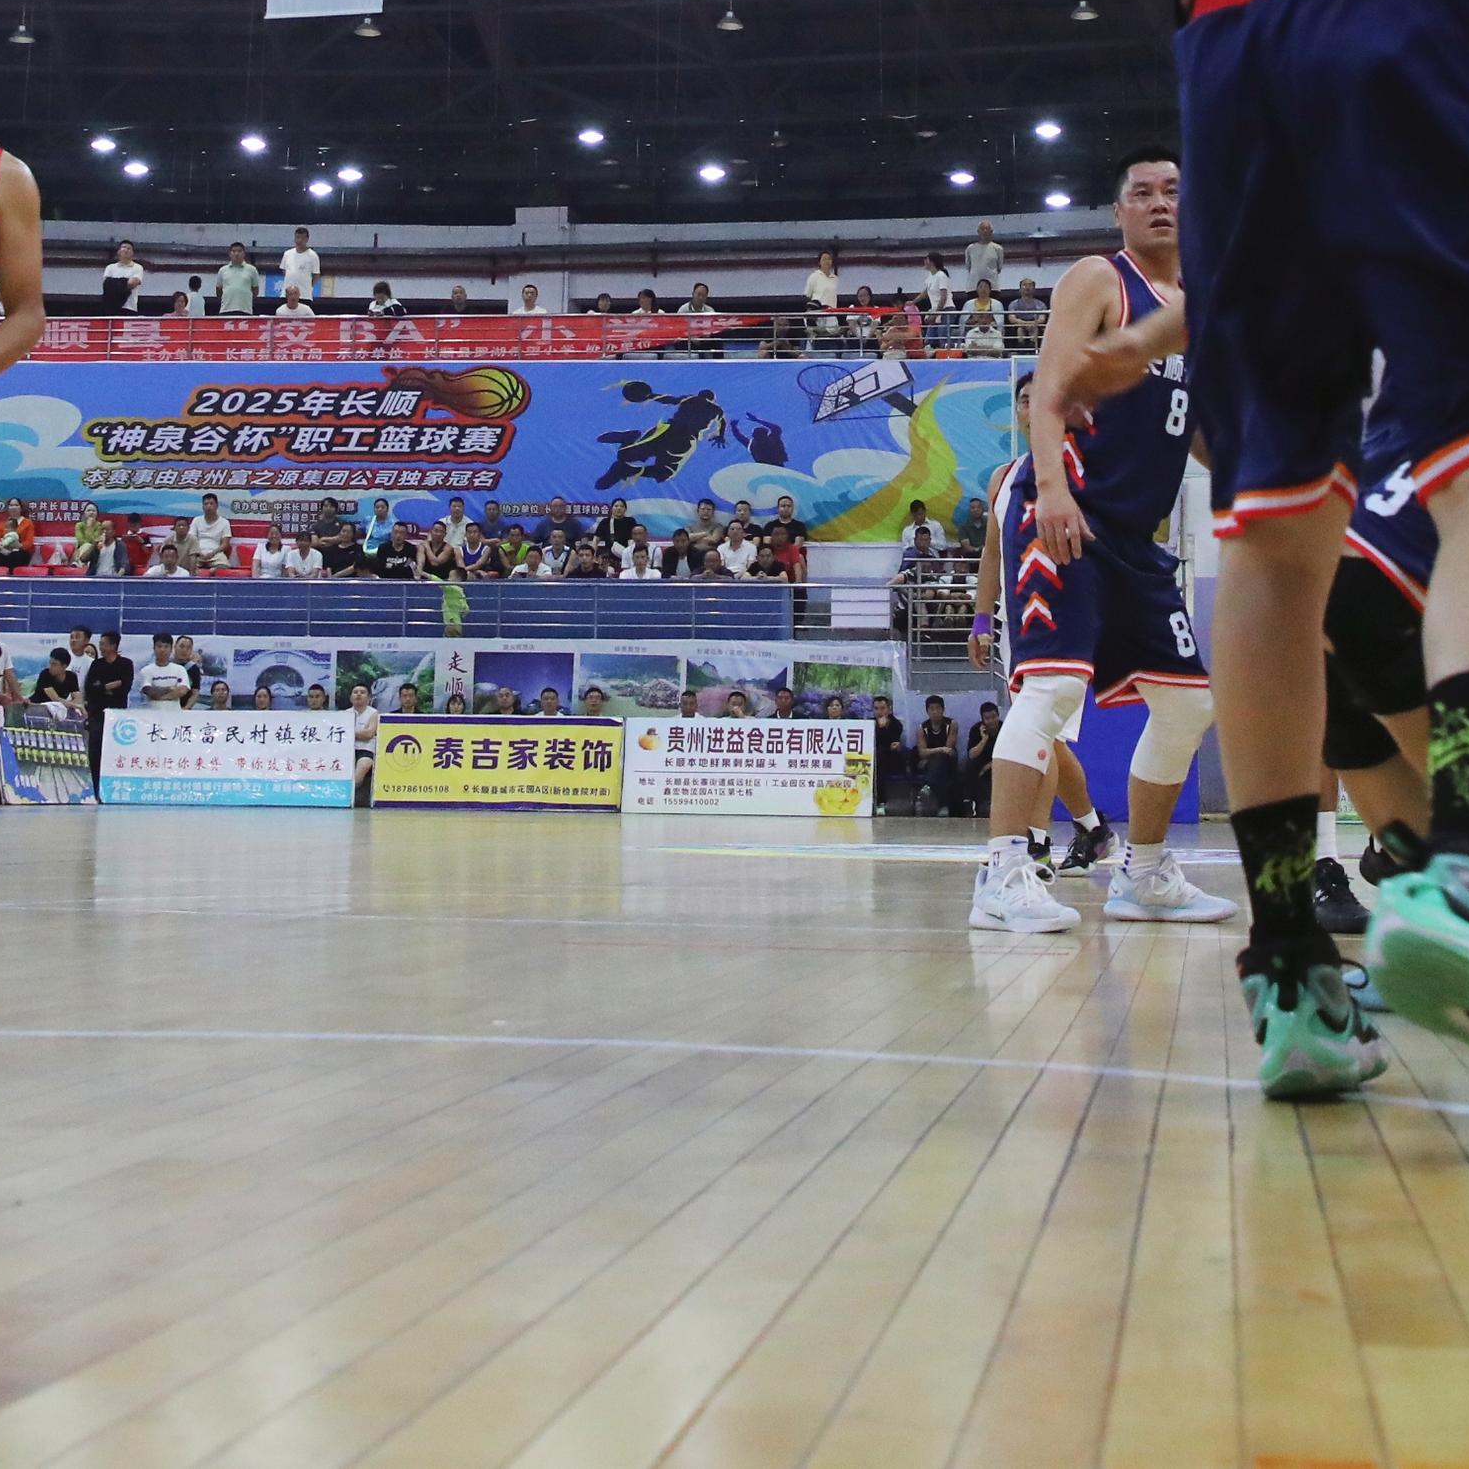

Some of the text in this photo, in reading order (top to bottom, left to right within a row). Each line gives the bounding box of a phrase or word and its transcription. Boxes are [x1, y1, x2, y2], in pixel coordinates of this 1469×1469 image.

[192, 388, 422, 417] 2025年长顺
[1165, 388, 1189, 437] 8
[91, 423, 502, 453] “神泉谷杯”职工篮球赛
[83, 468, 497, 488] 本赛事由贵州富之源集团公司独家冠名
[1168, 611, 1196, 658] 8
[147, 723, 346, 745] 长顺富民村镇银行
[667, 727, 864, 755] 贵州进益食品有限公司
[433, 738, 613, 772] 泰吉家装饰
[665, 758, 777, 769] 长顺本地鲜果刺梨罐头
[664, 798, 719, 806] 15599410002
